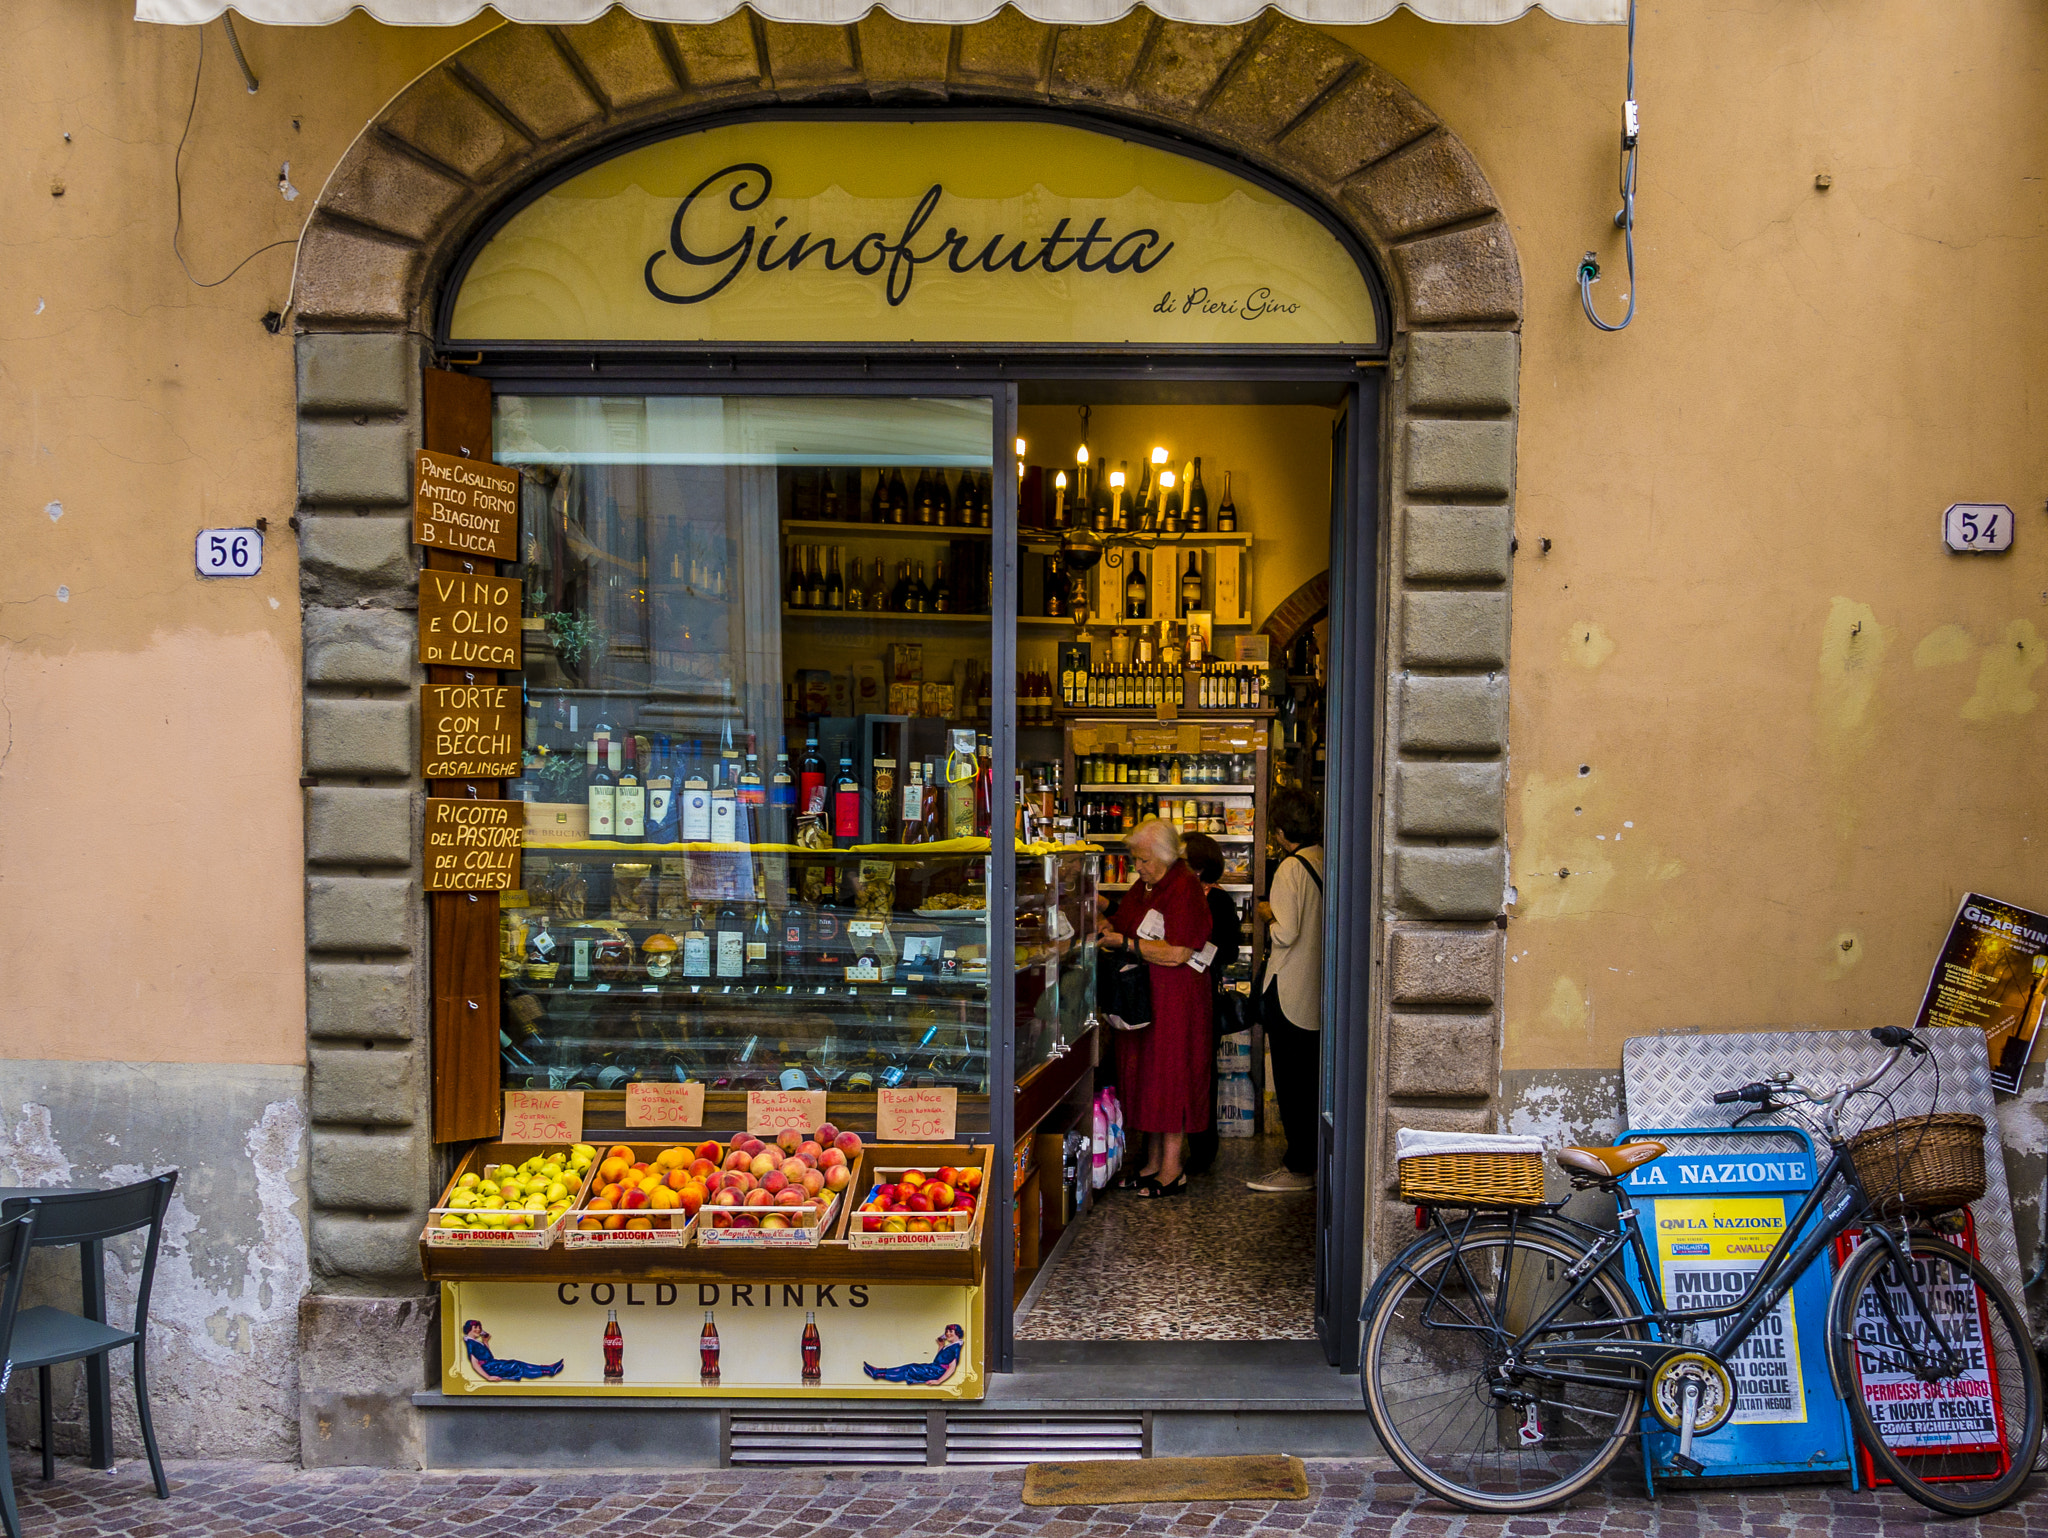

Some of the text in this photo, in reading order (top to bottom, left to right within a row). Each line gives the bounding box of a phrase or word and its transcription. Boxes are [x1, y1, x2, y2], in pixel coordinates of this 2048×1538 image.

[644, 162, 1175, 307] Ginofrutta
[1153, 287, 1300, 320] di Pieri Gino
[421, 458, 515, 494] PANE CASALINGO
[420, 480, 515, 514] ANTICO FORNO
[430, 502, 500, 534] BIAGIONI
[1962, 512, 1998, 543] 54
[449, 528, 496, 552] LUCCA
[211, 536, 248, 567] 56
[436, 577, 508, 606] VINO
[430, 610, 508, 634] E OLIO
[428, 640, 514, 664] DI LUCCA
[434, 688, 508, 708] TORTE
[438, 714, 500, 733] CON I
[436, 734, 511, 756] BECCHI
[426, 761, 518, 776] CASALINGHE
[436, 804, 508, 825] RICOTTA
[430, 824, 522, 848] DEL PASTORE
[542, 829, 588, 838] BRUCIAT
[435, 851, 514, 870] DEI COLLI
[433, 872, 512, 889] LUCCHESI
[1964, 906, 2048, 945] GRAPEVIN
[512, 1092, 562, 1110] PERINE
[777, 1092, 812, 1104] BIANCA
[881, 1090, 942, 1104] PESCA NOCE
[1630, 1162, 1806, 1185] LA NAZIONE
[1660, 1218, 1782, 1229] QN LA NAZIONE
[452, 1232, 470, 1240] agri
[472, 1232, 514, 1240] BOLOGNA
[591, 1233, 610, 1241] agri
[612, 1232, 655, 1240] BOLOGNA
[878, 1236, 896, 1244] agri
[898, 1235, 936, 1243] BOLOGNA
[1726, 1244, 1774, 1254] CAVALLO
[558, 1282, 870, 1308] COLD DRINKS
[1750, 1362, 1788, 1376] OCCHI
[1737, 1379, 1790, 1394] MOGLIE
[1865, 1380, 1989, 1401] PERMESSI SUL LAVORO
[1764, 1397, 1792, 1410] NEGOZI
[1890, 1402, 1936, 1420] NUOVE
[1938, 1400, 1992, 1418] REGOLE
[1880, 1422, 1914, 1434] COME
